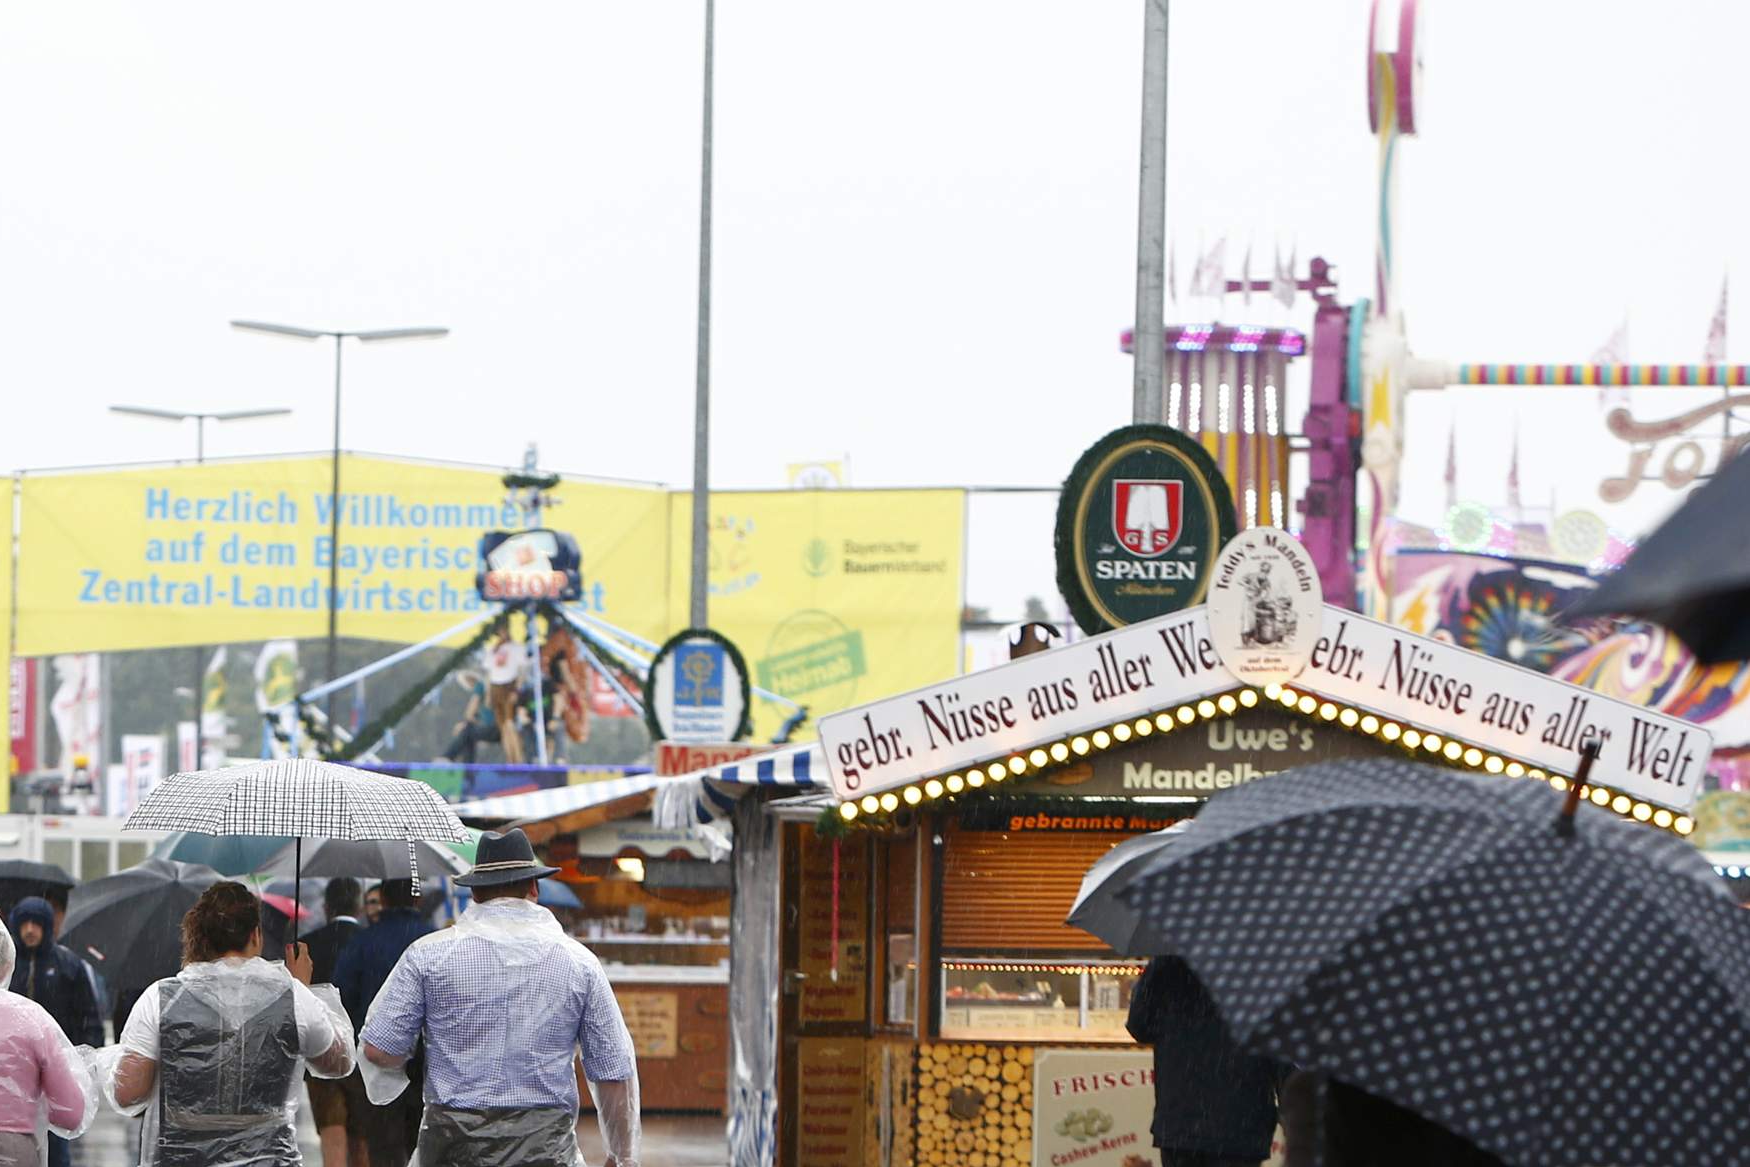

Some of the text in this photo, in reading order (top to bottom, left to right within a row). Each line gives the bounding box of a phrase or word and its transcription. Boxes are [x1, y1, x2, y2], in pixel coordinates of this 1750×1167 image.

[145, 487, 541, 529] Herzlich Willkommen
[145, 532, 205, 563] auf
[220, 534, 296, 566] dem
[1264, 534, 1312, 592] Mandeln
[484, 570, 569, 598] SHOP
[1095, 560, 1197, 580] SPATEN
[837, 620, 1226, 790] gebr. Nüsse aus aller We
[1293, 620, 1695, 789] ebr. Nüsse aus aller Welt
[1123, 762, 1292, 790] Mandelb
[1010, 813, 1124, 832] gebrannte
[1051, 1133, 1139, 1167] Cashew-Kerne
